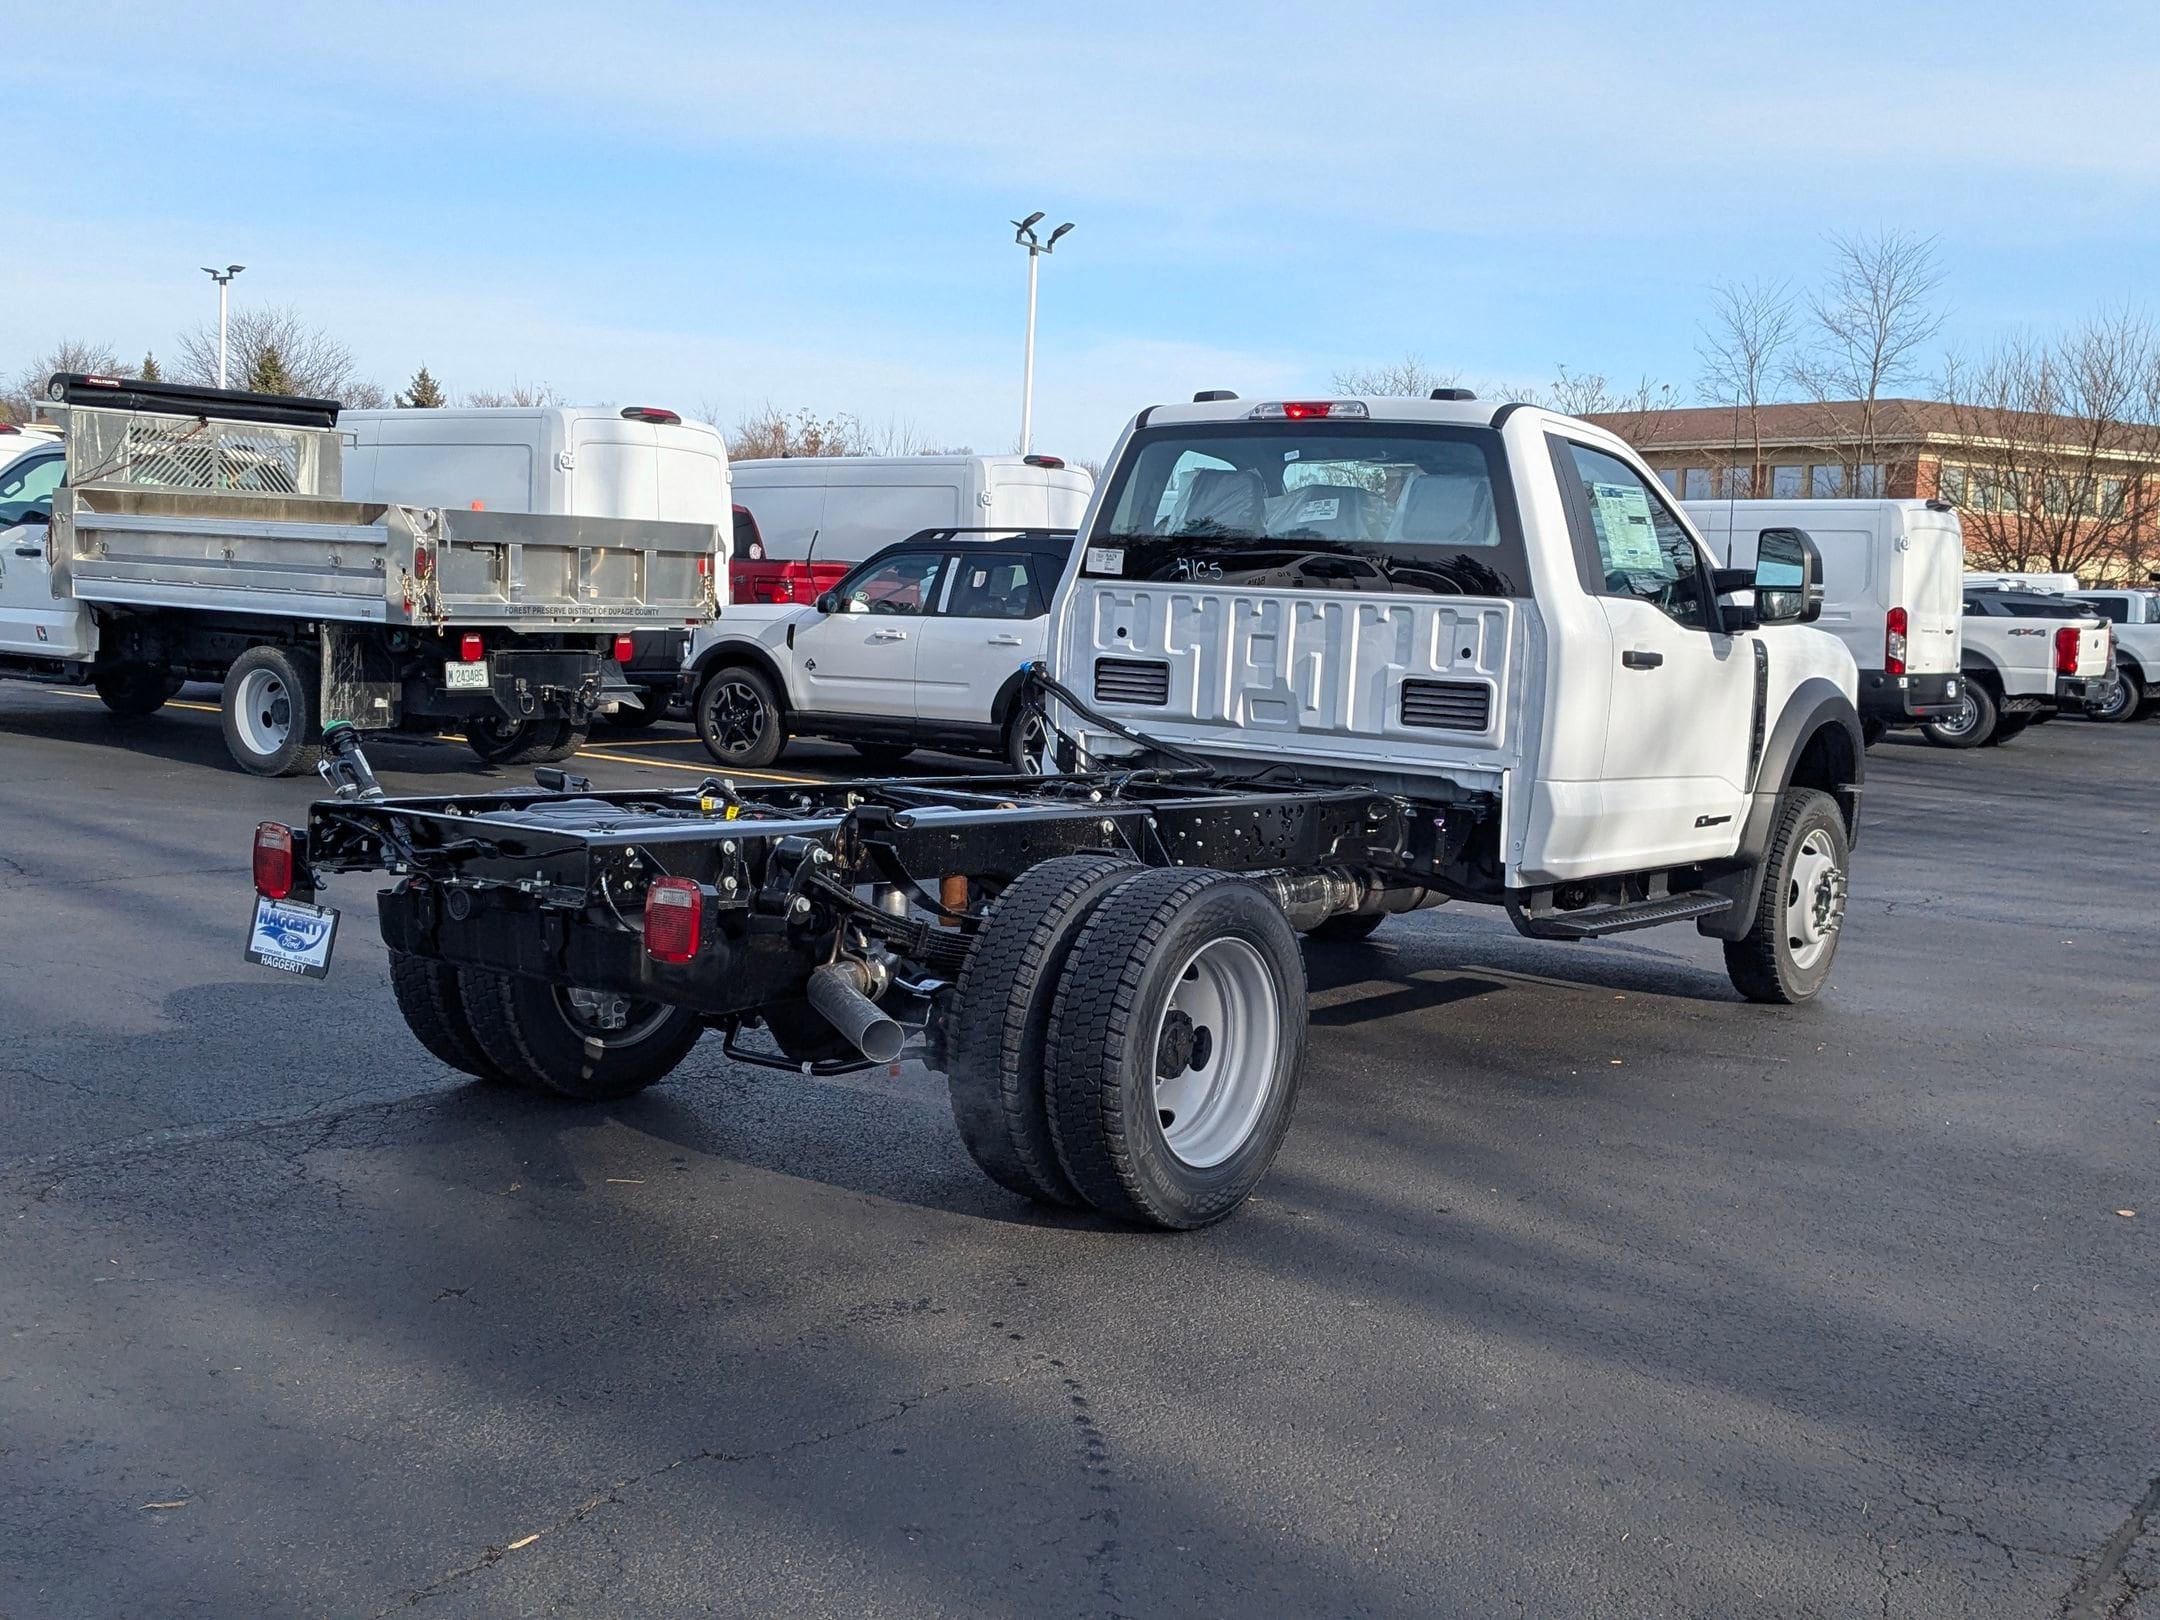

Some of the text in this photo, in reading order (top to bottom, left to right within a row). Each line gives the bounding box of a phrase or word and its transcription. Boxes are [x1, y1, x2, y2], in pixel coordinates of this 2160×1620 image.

[504, 606, 660, 616] FOREST PRESERVE DISTRICT OF DUPAGE COUNTY
[258, 907, 332, 936] HAGGERTY
[281, 934, 301, 950] Ford
[260, 953, 307, 974] HAGGERTY
